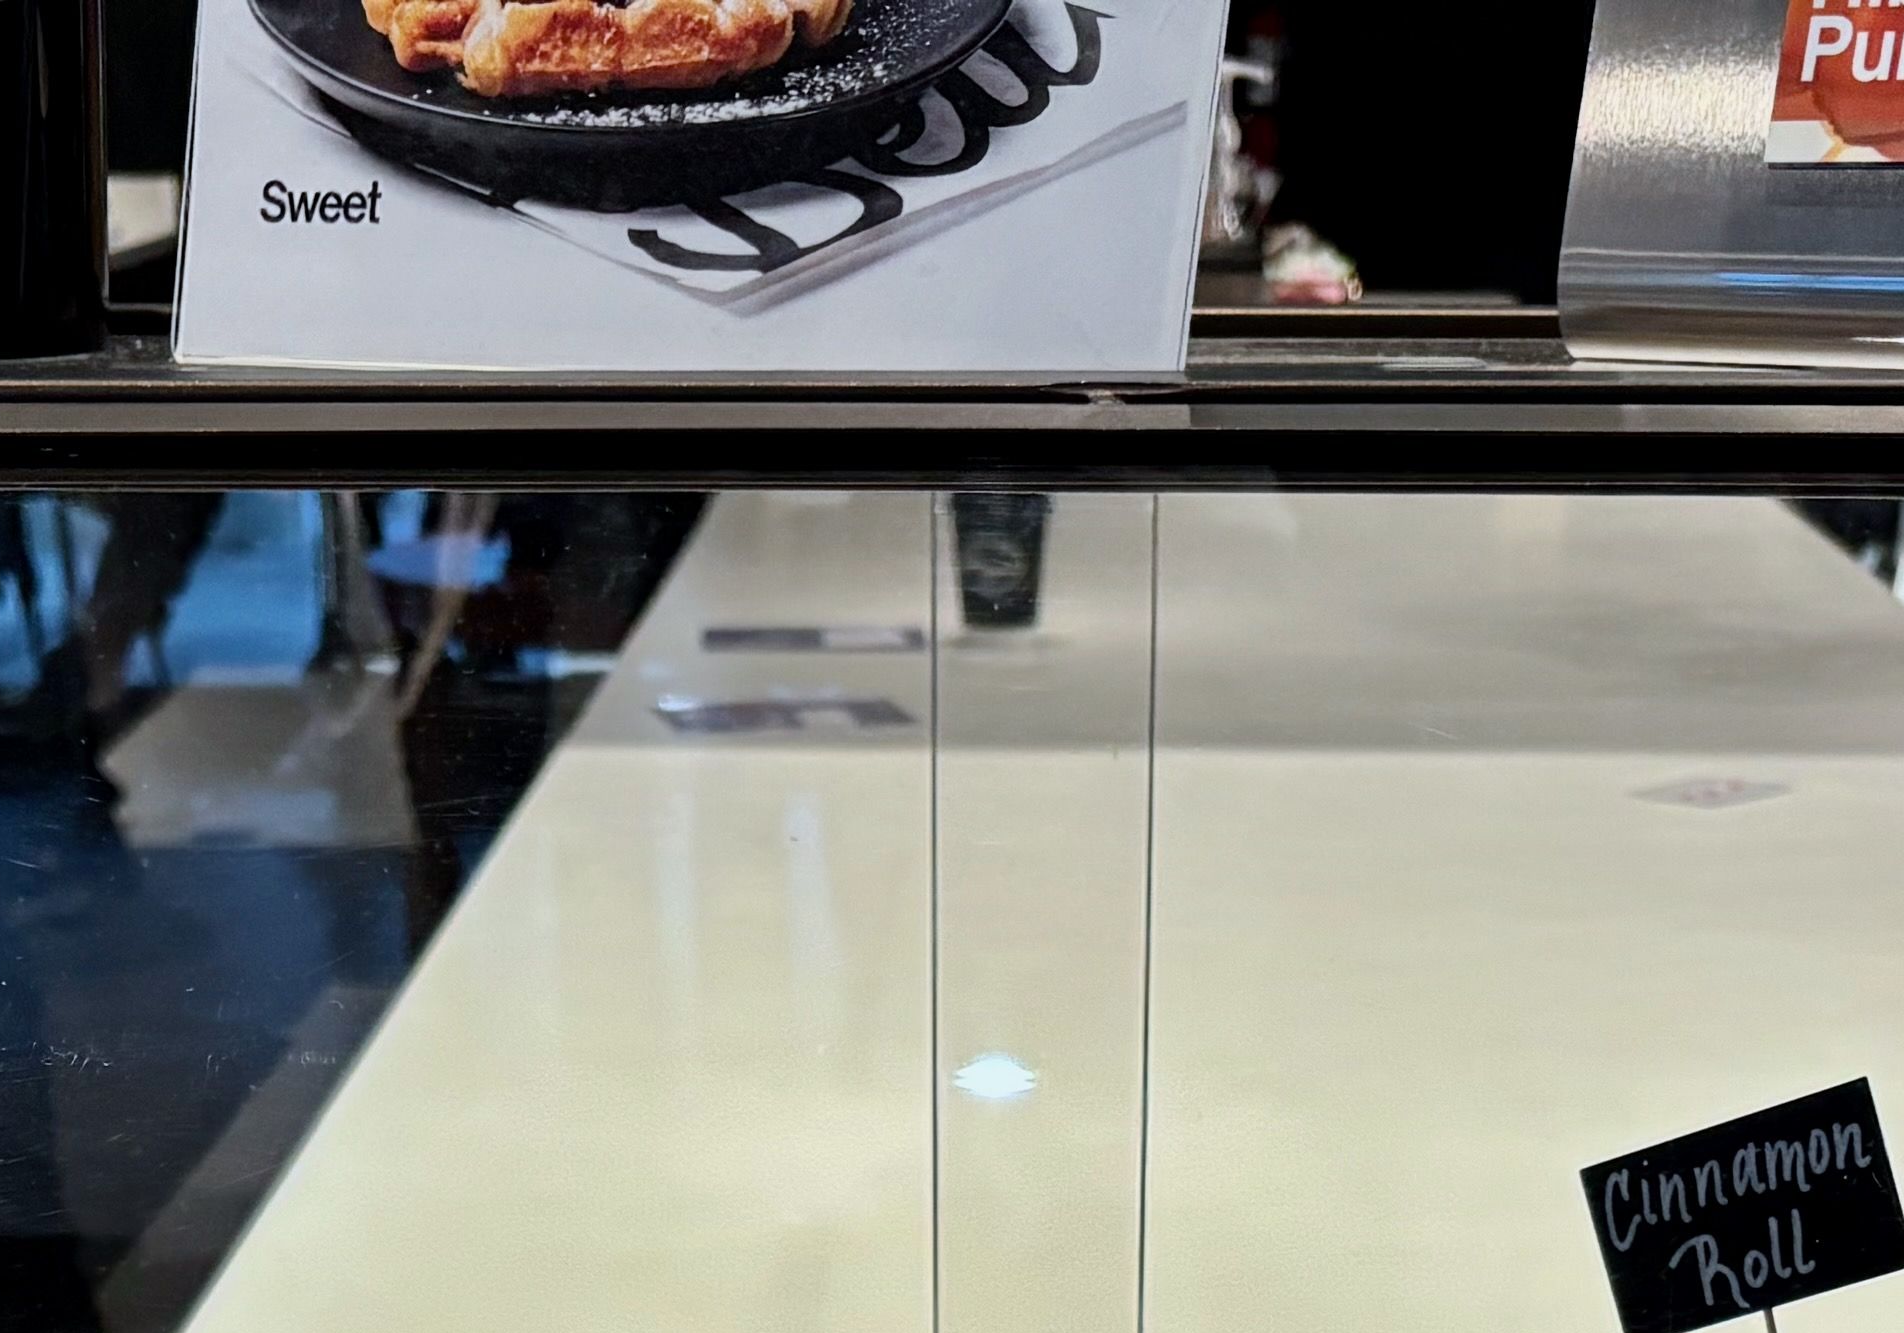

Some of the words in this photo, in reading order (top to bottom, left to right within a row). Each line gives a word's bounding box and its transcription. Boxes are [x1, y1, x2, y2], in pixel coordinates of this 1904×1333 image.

[260, 179, 382, 226] Sweet
[1604, 1122, 1872, 1252] Cinnamon
[1667, 1208, 1817, 1310] Roll
